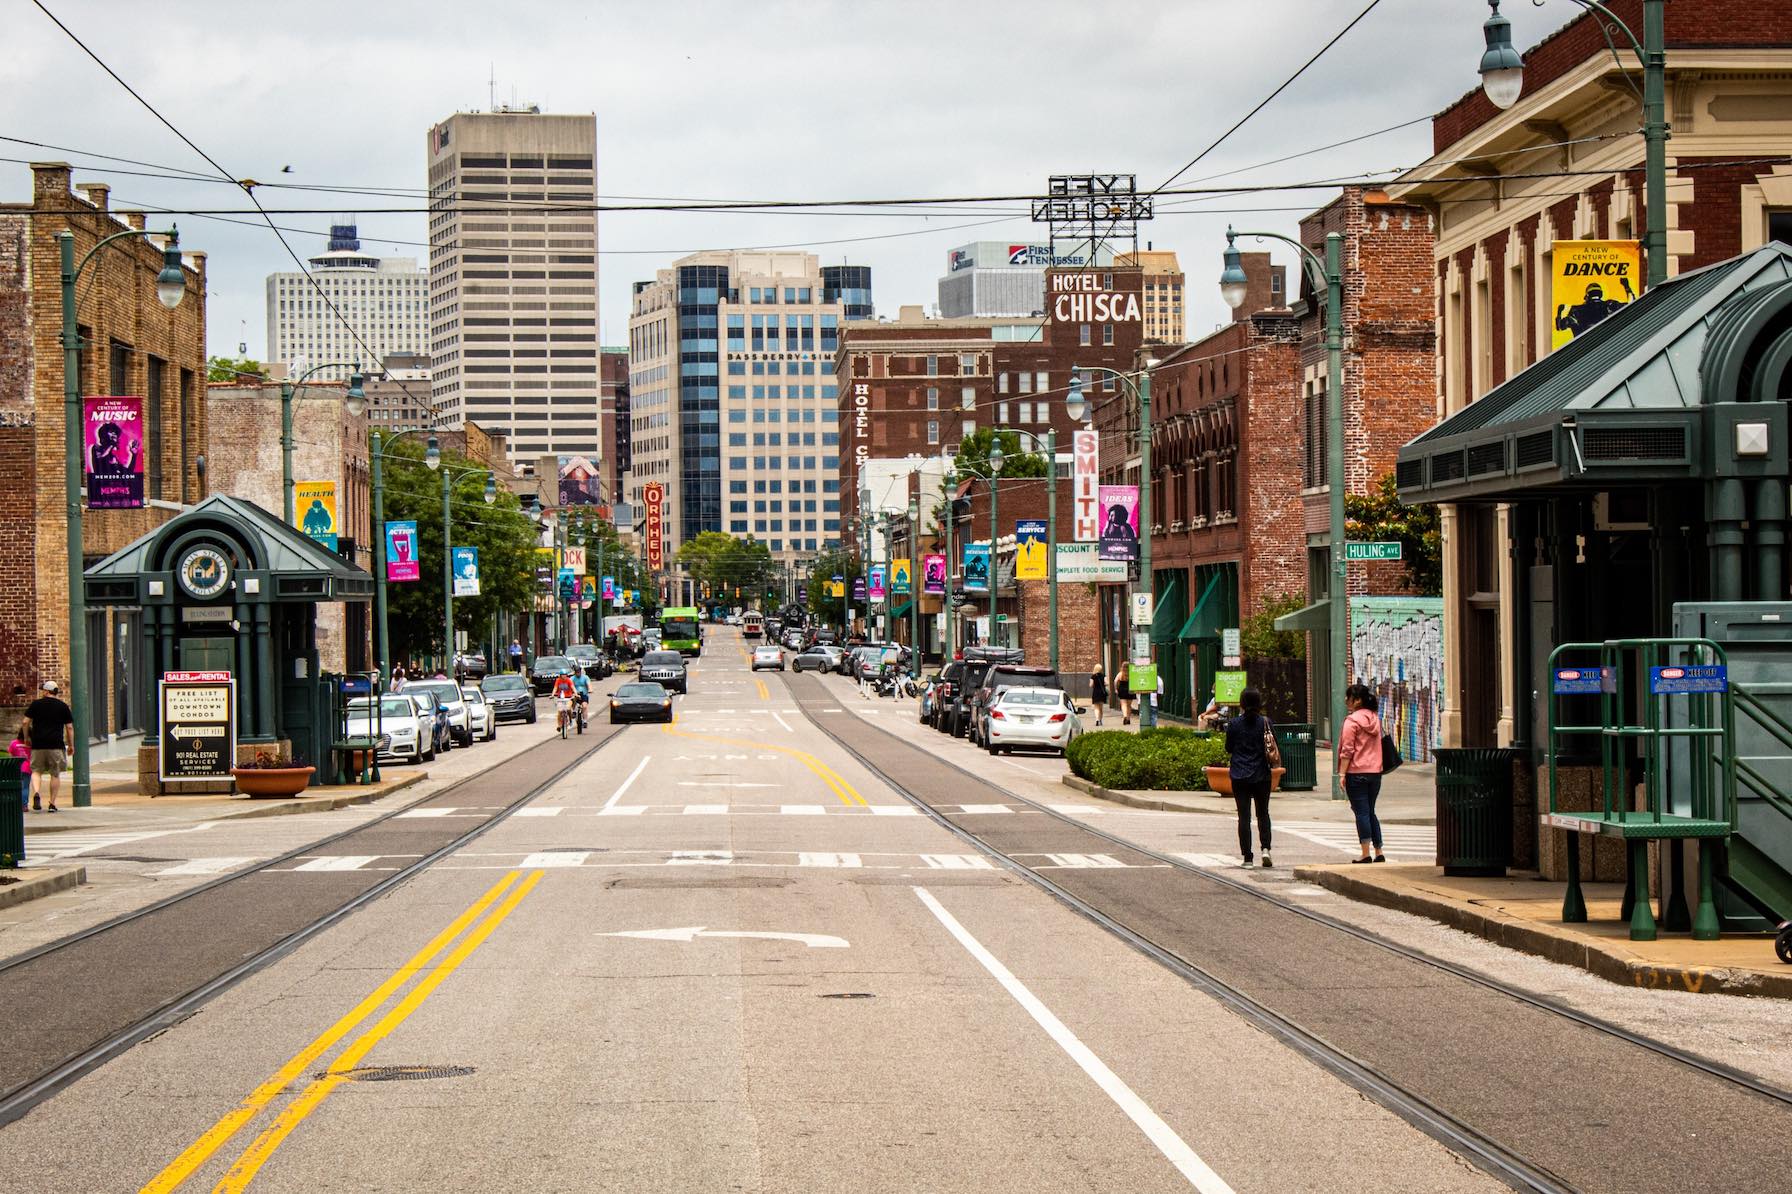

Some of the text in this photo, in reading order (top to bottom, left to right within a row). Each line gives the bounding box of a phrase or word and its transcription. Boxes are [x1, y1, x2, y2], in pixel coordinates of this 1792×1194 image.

[1563, 262, 1629, 276] DANCE
[1053, 275, 1103, 291] HOTEL
[1055, 294, 1142, 321] CHISCA
[91, 411, 138, 421] MUSIC
[855, 384, 869, 438] HOTEL
[1078, 433, 1096, 539] SMITH
[647, 490, 660, 571] ORPHEUM
[1056, 545, 1091, 553] ISCOUNT
[1349, 545, 1385, 558] HULING
[167, 673, 190, 681] SALES
[201, 672, 228, 680] RENTAL
